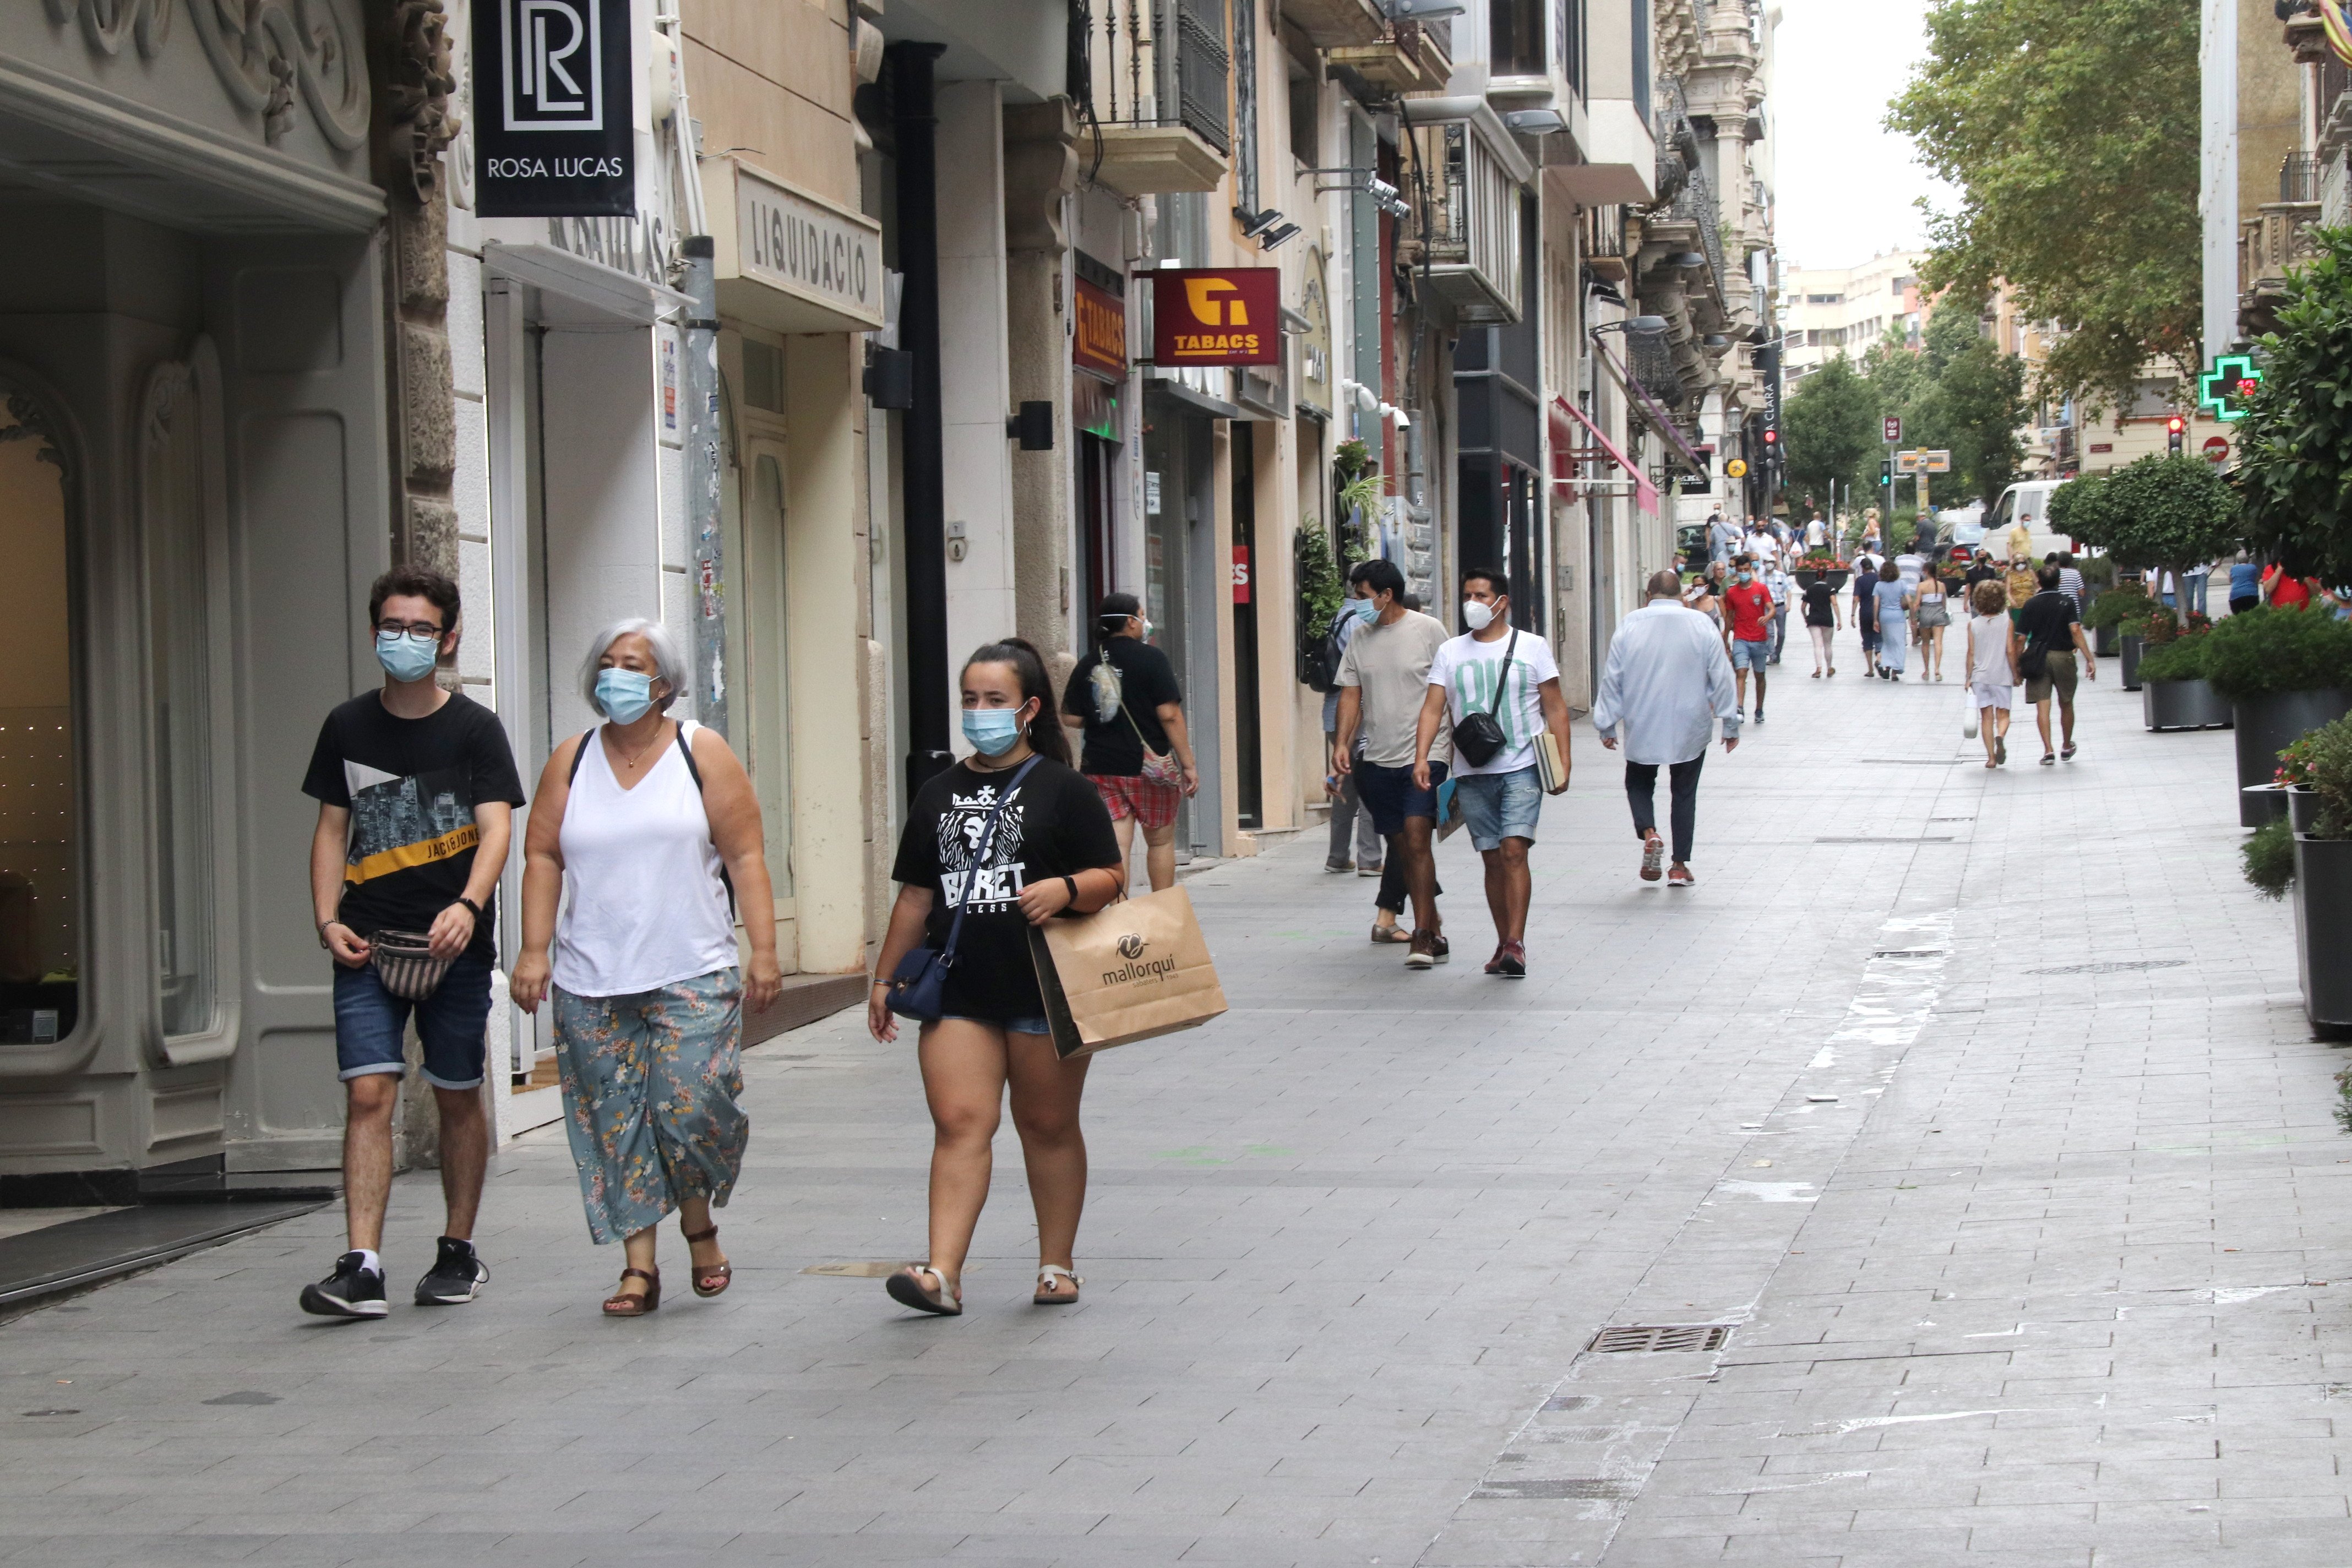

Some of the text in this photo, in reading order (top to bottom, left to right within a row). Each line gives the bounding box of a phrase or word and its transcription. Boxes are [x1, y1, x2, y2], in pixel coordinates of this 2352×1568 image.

[488, 157, 623, 178] ROSA LUCAS
[752, 200, 865, 303] LIQUIDACIÓ
[1086, 299, 1124, 357] TABACS
[1174, 334, 1259, 349] TABACS
[1764, 383, 1775, 421] CLARA
[967, 903, 1007, 914] LESS
[1102, 954, 1175, 985] mallorquí
[1133, 977, 1158, 988] sabaters
